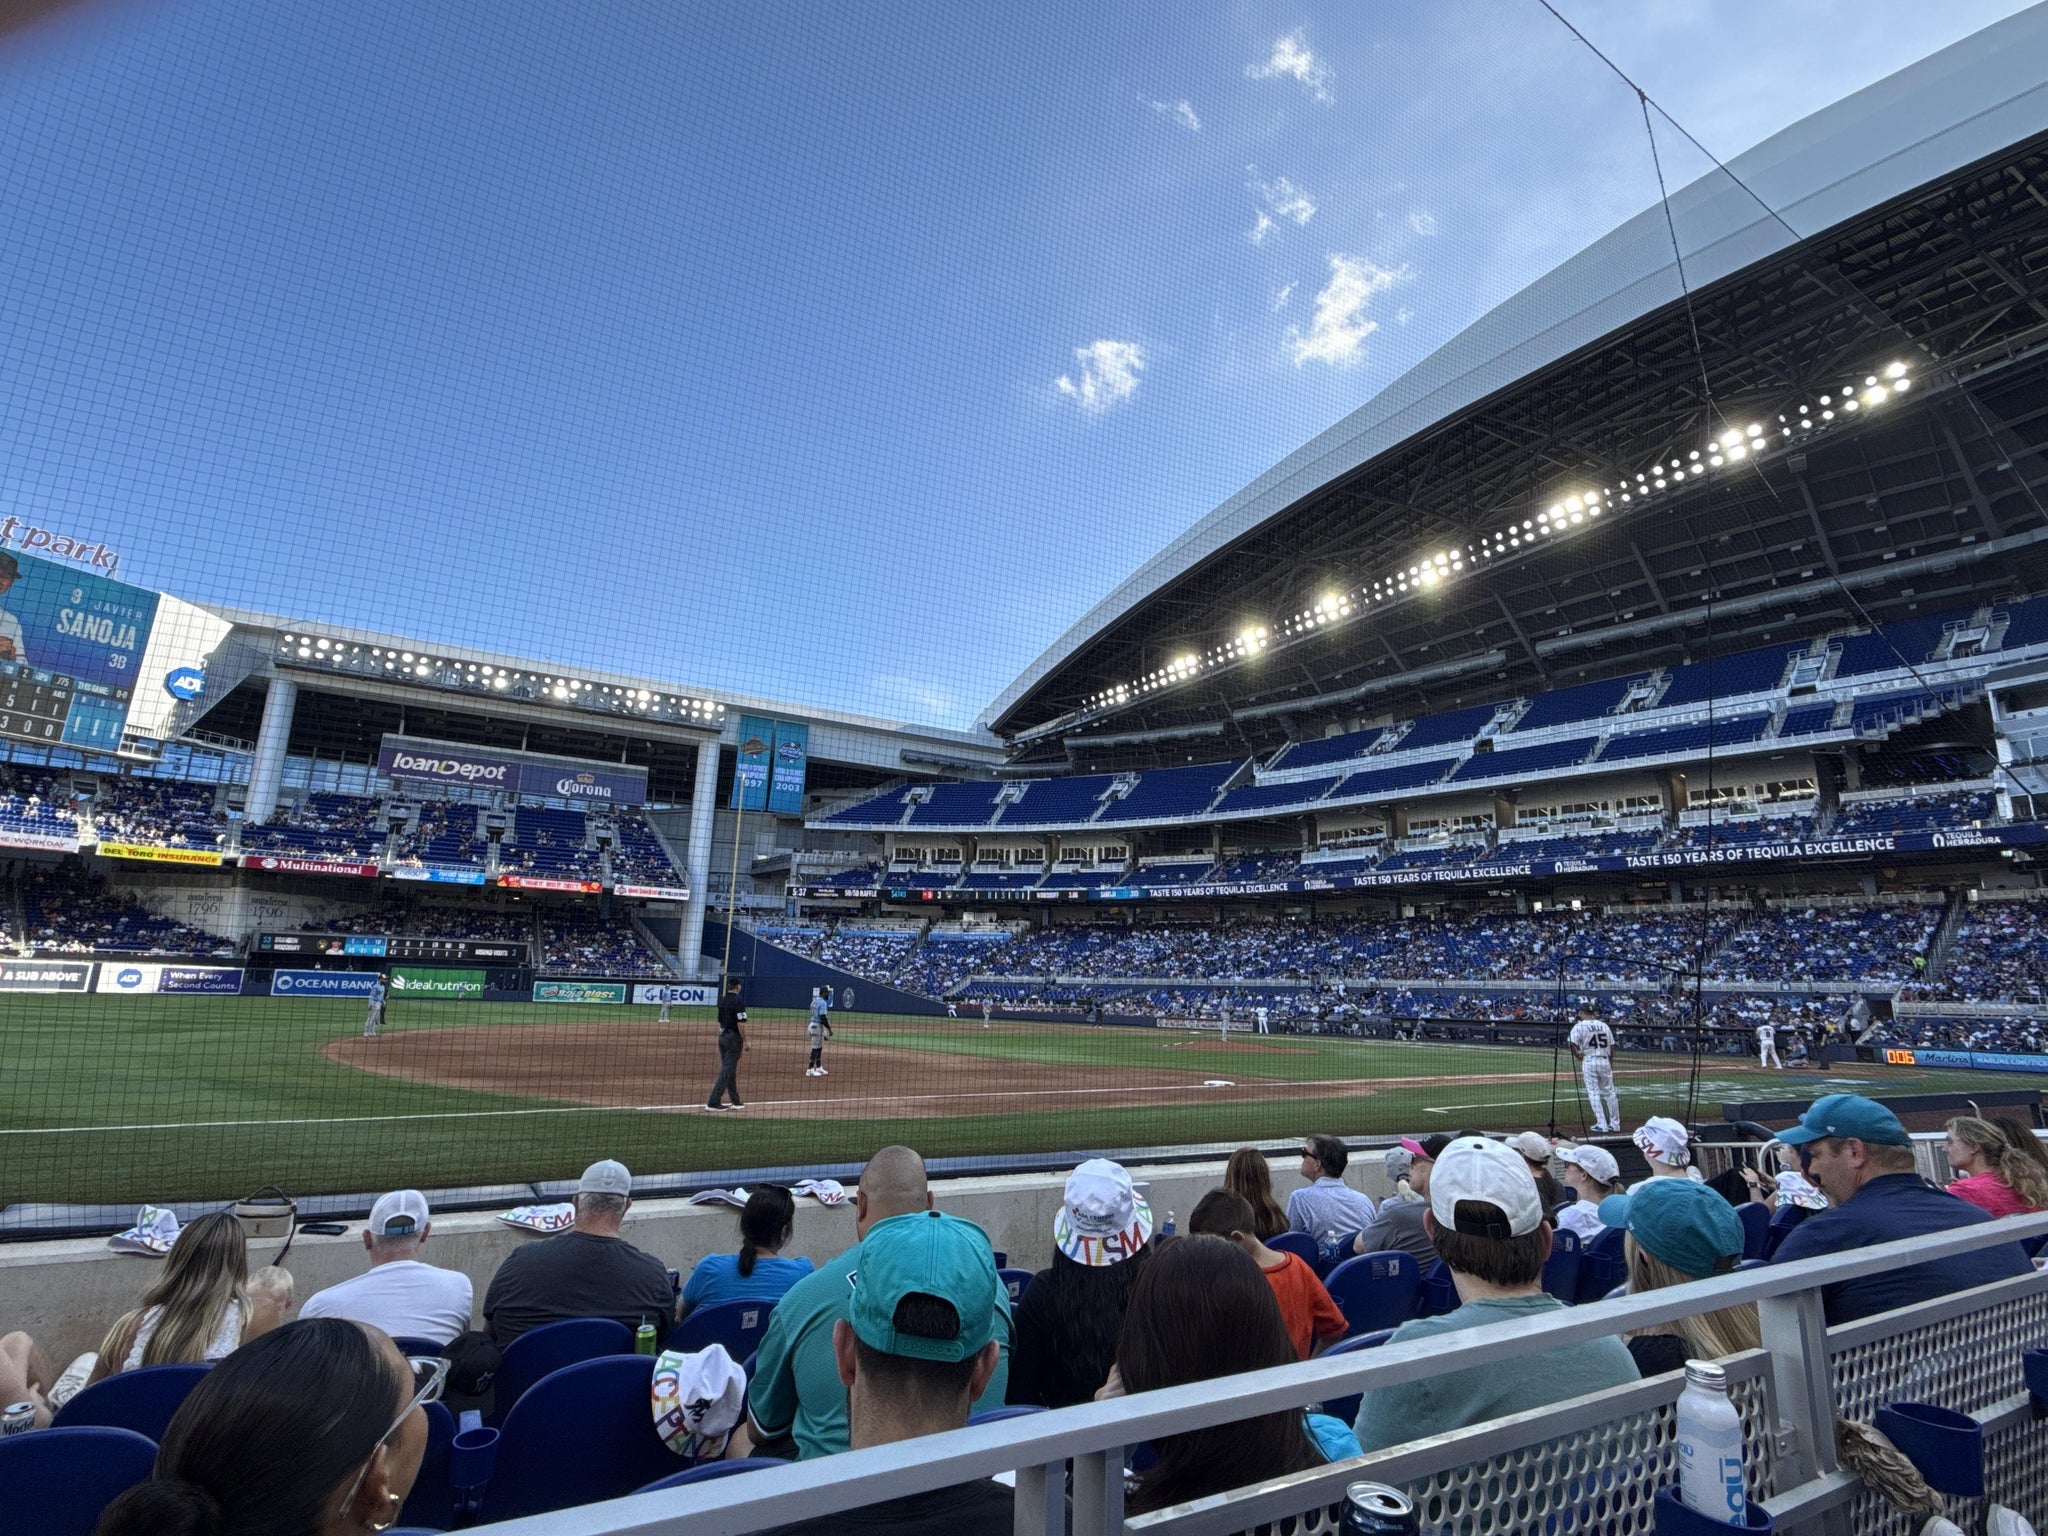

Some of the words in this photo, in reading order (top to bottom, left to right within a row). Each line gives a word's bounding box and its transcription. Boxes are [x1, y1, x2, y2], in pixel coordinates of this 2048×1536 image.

[21, 527, 114, 569] park
[94, 601, 142, 621] JAVIER
[56, 608, 136, 650] SANOJA
[108, 653, 127, 669] 3B
[21, 668, 29, 678] 2
[173, 675, 204, 694] ADT
[6, 694, 15, 708] 5
[0, 715, 9, 729] 3
[23, 720, 33, 733] 0
[44, 724, 54, 737] 0
[392, 752, 508, 780] loanDepot
[556, 778, 612, 798] Corona
[744, 779, 762, 788] 997
[776, 783, 800, 792] 2003
[1946, 831, 1982, 840] TEQUILA
[1946, 836, 2001, 848] HERRADURA
[15, 838, 65, 848] WORKDAY
[104, 847, 123, 855] DEL
[125, 846, 154, 858] TORO
[157, 852, 218, 863] INSURANCE
[1626, 855, 1660, 868] TASTE
[1662, 853, 1681, 865] 150
[1684, 851, 1724, 863] YEARS
[1727, 849, 1743, 860] OF
[1745, 845, 1802, 860] TEQUILA
[1805, 838, 1895, 856] EXCELLENCE
[279, 859, 363, 875] Multinational
[1563, 864, 1598, 873] HERRADURA
[1353, 876, 1377, 886] TASTE
[1378, 875, 1391, 885] 150
[1392, 873, 1420, 883] YEARS
[1421, 872, 1432, 882] OF
[1434, 869, 1471, 881] TEQUILA
[1473, 864, 1531, 878] EXCELLENCE
[792, 887, 807, 897] 5:37
[860, 890, 878, 898] RAFFLE
[1150, 888, 1170, 897] TASTE
[1171, 887, 1182, 897] 150
[1183, 886, 1204, 896] YEARS
[1205, 886, 1214, 895] OF
[1215, 884, 1245, 895] TEQUILA
[1246, 882, 1288, 893] EXCELLENCE
[188, 902, 218, 916] 1796
[253, 905, 282, 920] 1796
[18, 950, 36, 958] 387
[4, 972, 13, 980] A
[15, 971, 39, 981] SUB
[41, 972, 80, 982] ABOVE
[120, 974, 140, 983] ADT
[170, 971, 196, 980] When
[199, 972, 223, 982] Every
[168, 981, 200, 989] Second
[203, 981, 238, 990] Counts.
[295, 979, 338, 989] OCEAN
[341, 980, 375, 990] BANK
[406, 979, 481, 991] idealnutrion
[557, 989, 584, 999] Baja
[584, 989, 615, 999] Blast
[1589, 1033, 1608, 1049] 45
[1925, 1053, 1969, 1064] Marlins
[1056, 1216, 1145, 1267] AUTISM
